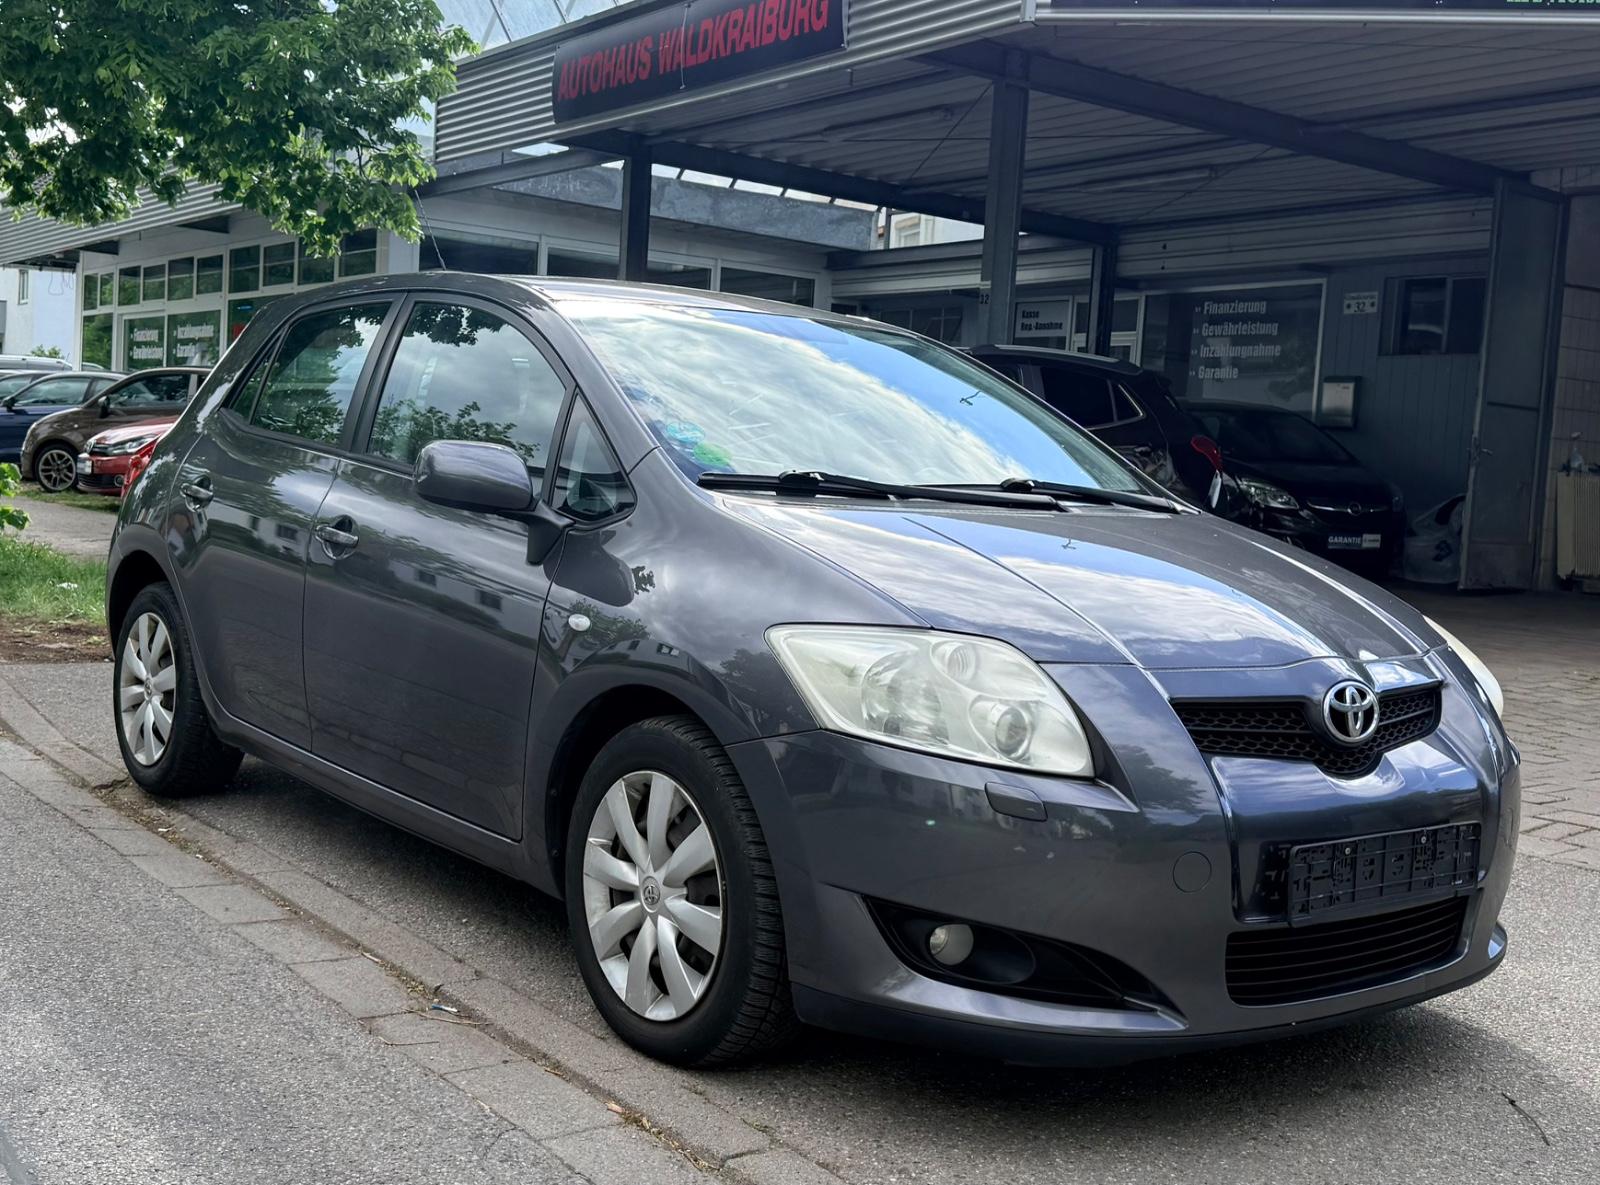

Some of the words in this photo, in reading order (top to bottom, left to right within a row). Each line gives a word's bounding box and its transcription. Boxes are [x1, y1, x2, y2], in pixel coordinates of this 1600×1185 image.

[558, 36, 652, 100] AUTOHAUS
[658, 0, 829, 75] WALDKRAIBURG
[1203, 301, 1267, 314] Finanzierung
[1354, 301, 1366, 312] 32
[1201, 321, 1279, 336] Gewährleistung
[1200, 343, 1281, 358] Inzahlungnahme
[1198, 366, 1239, 379] Garantie
[1328, 536, 1361, 544] GARANTIE
